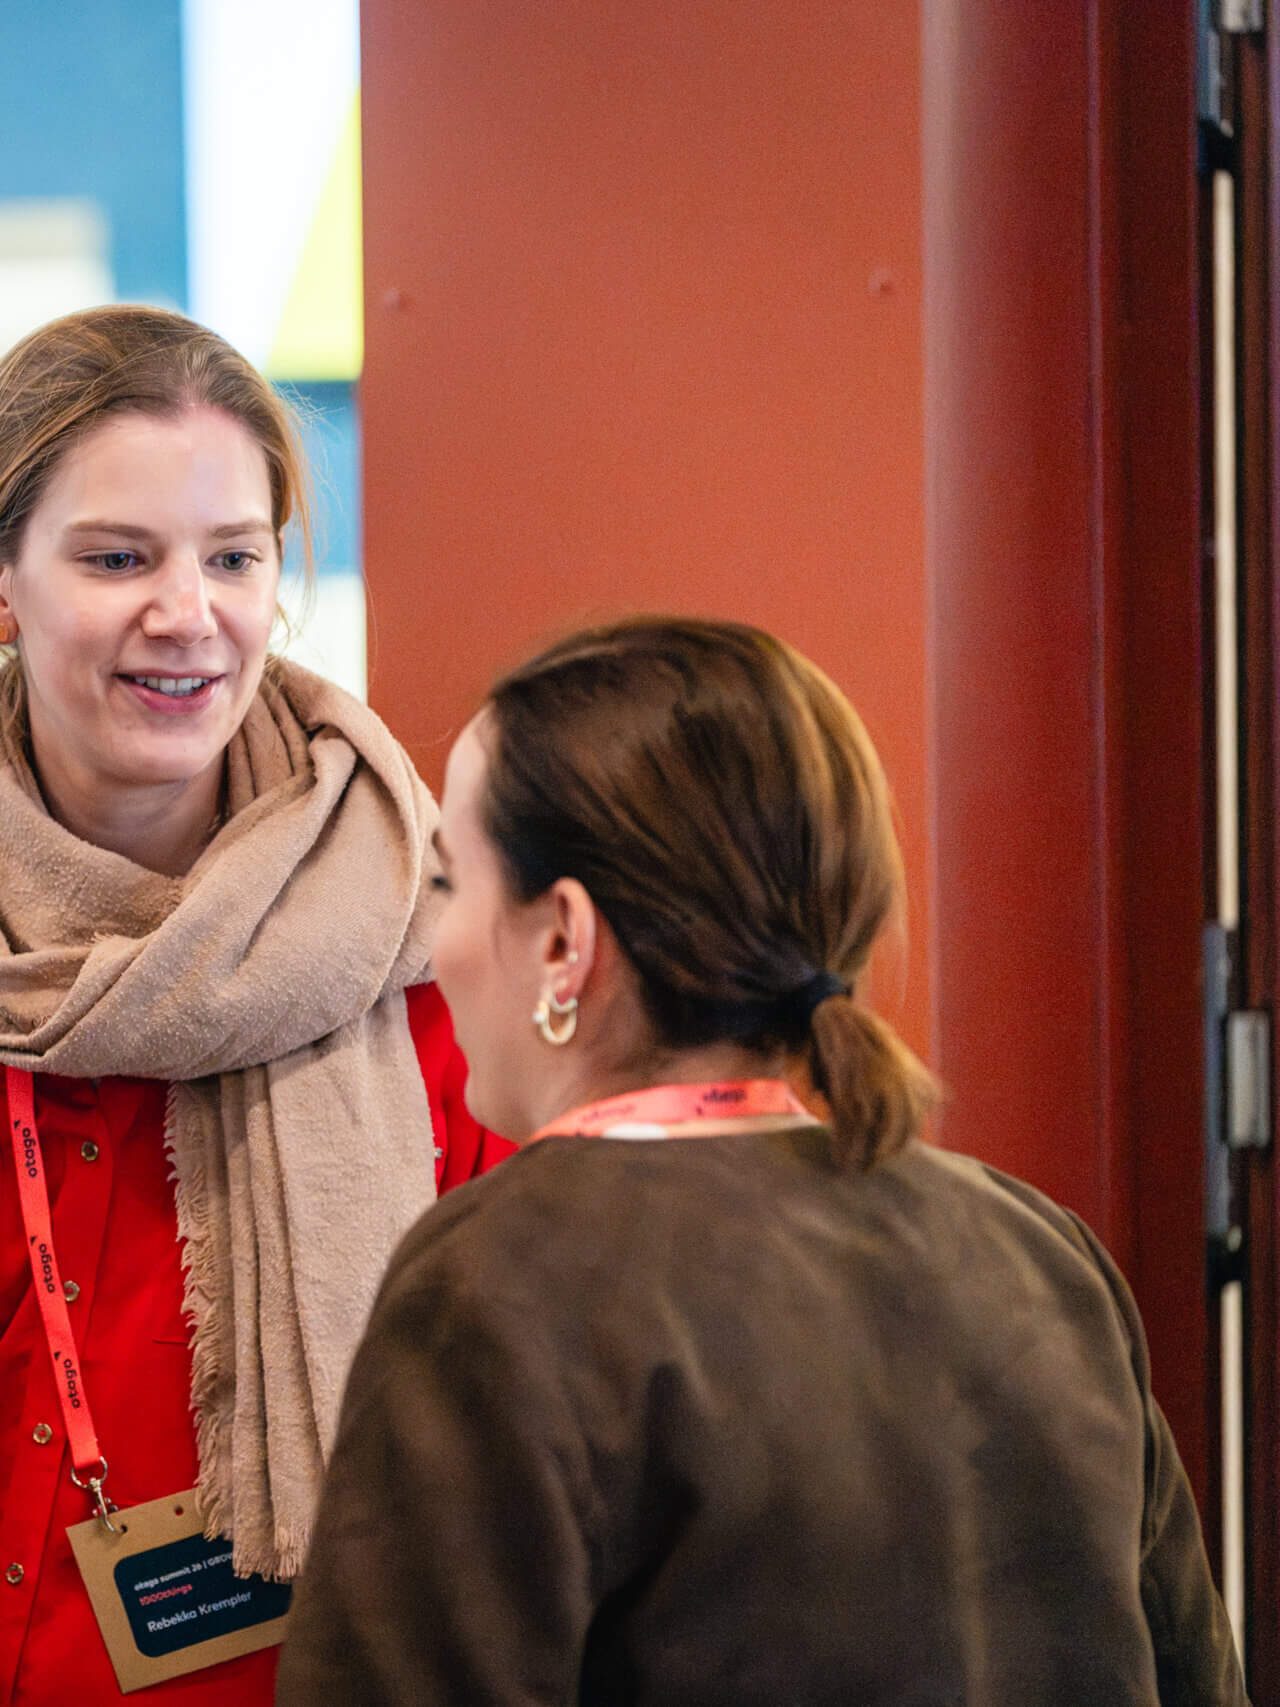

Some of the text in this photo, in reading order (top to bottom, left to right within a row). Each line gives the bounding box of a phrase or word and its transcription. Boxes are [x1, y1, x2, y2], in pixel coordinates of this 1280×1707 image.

[22, 1127, 38, 1178] otago
[38, 1243, 55, 1294] otago
[63, 1358, 81, 1408] otago
[148, 1592, 252, 1632] Rebekka Krempler
